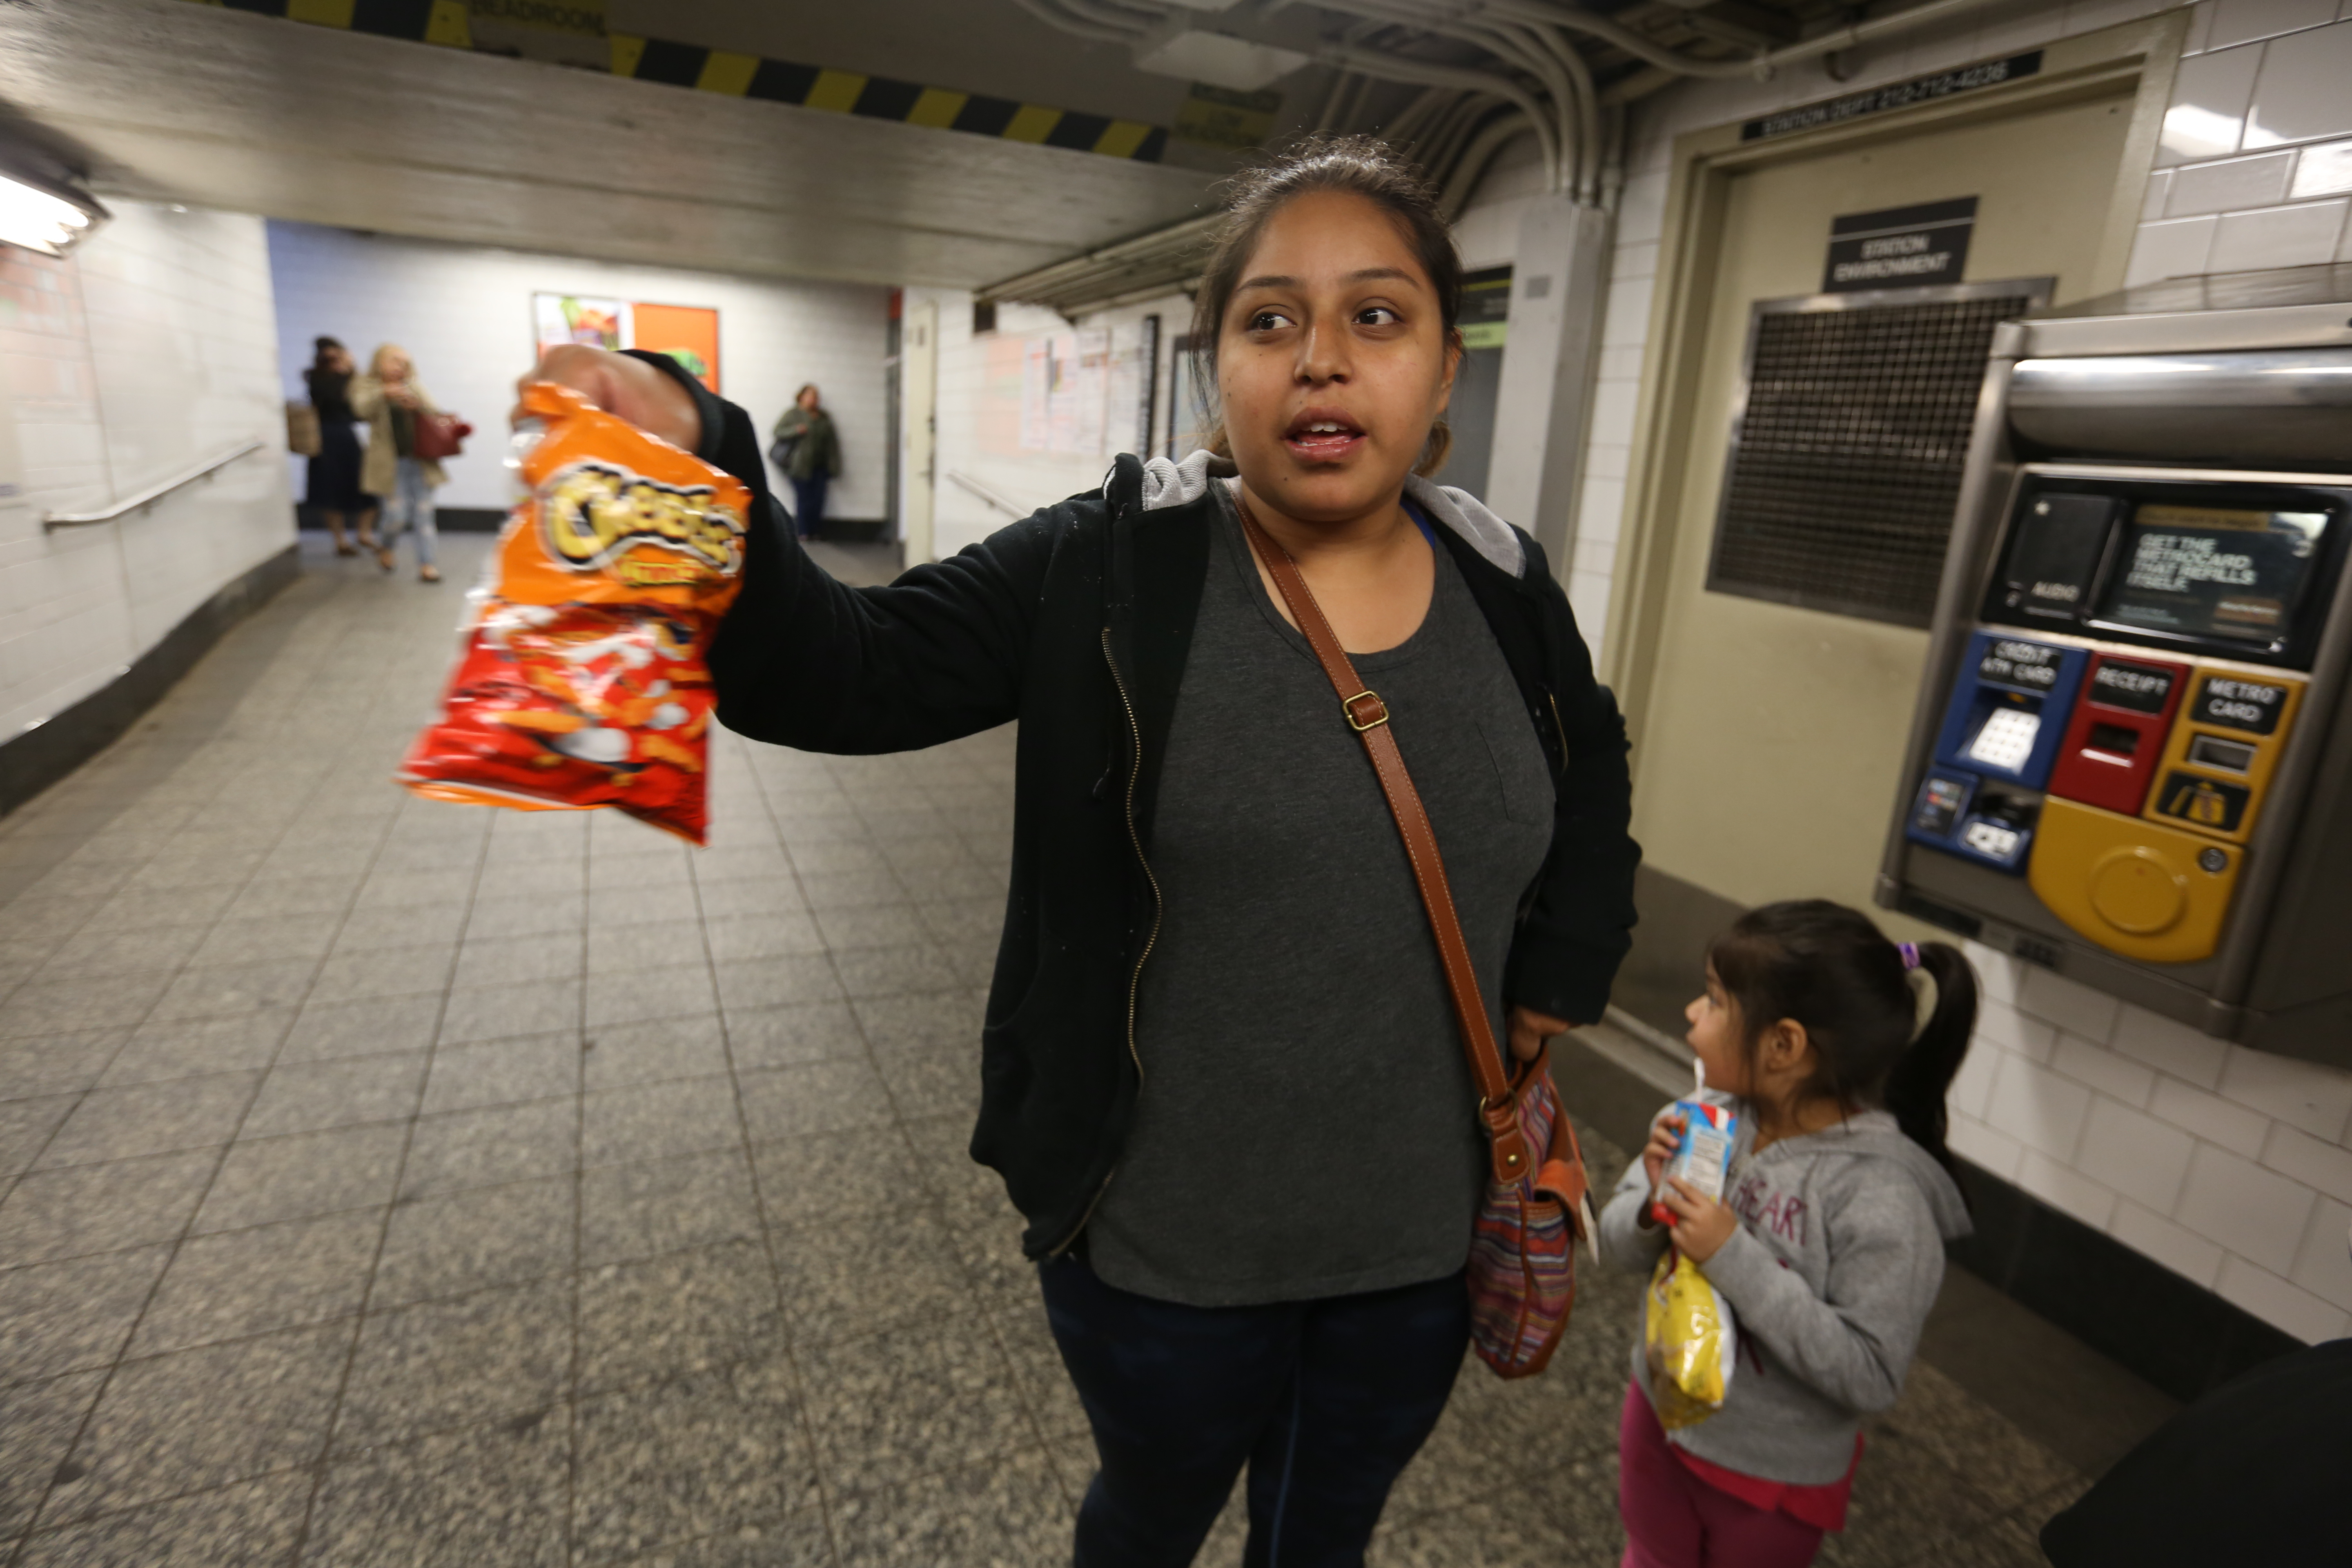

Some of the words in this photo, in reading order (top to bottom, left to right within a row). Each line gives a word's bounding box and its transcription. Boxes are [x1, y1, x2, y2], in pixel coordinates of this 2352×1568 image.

[1860, 233, 1930, 260] STATION
[1833, 251, 1952, 283] ENVIRONMENT
[2139, 533, 2178, 550] GET
[2180, 537, 2217, 555] THE
[2030, 581, 2080, 602] AUDIO
[2013, 663, 2057, 685] CARD
[2095, 666, 2168, 696] RECEIPT
[2207, 677, 2277, 705] METRO
[2208, 698, 2263, 722] CARD
